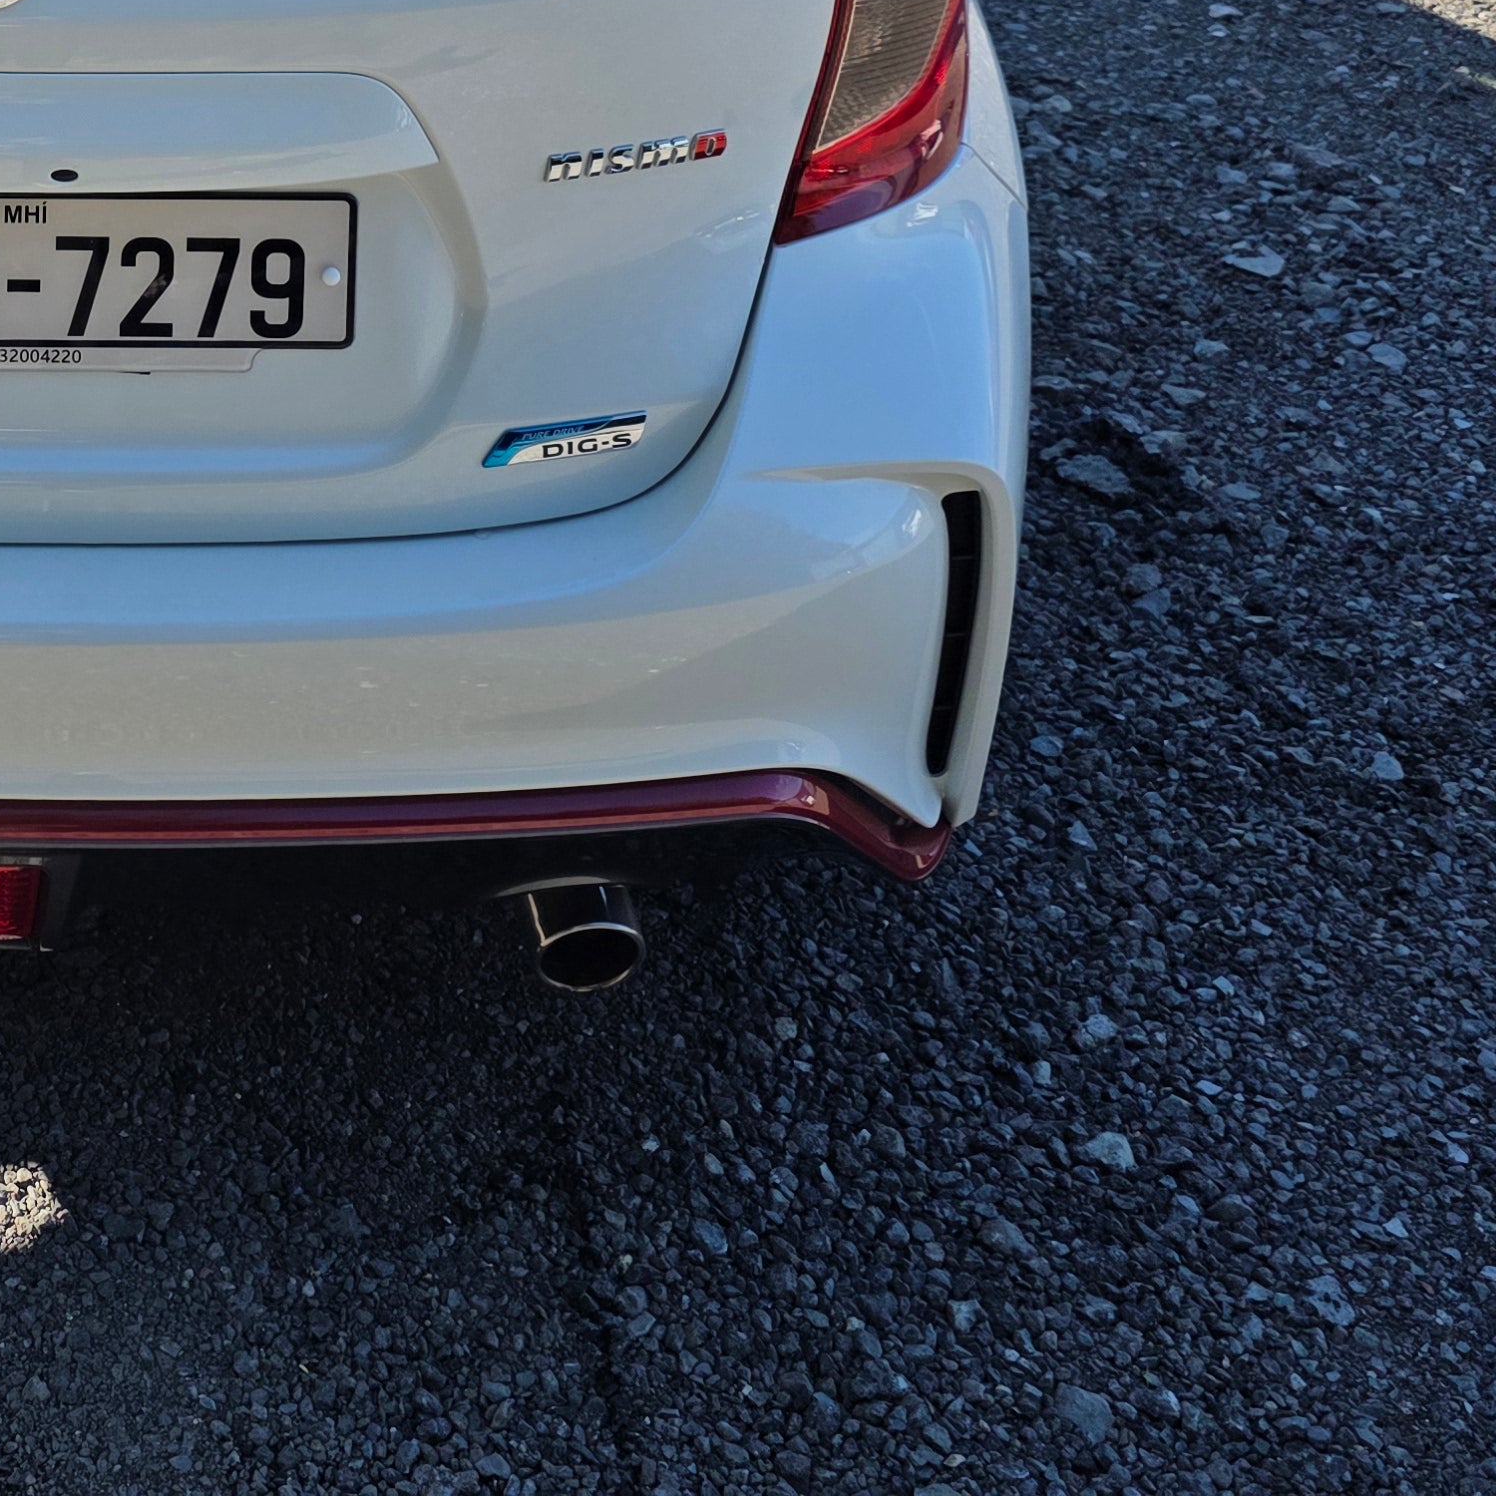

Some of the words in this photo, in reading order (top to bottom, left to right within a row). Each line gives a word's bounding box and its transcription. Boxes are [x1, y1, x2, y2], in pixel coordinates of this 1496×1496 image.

[543, 127, 728, 183] nismo
[4, 200, 48, 225] MHÍ
[521, 430, 551, 441] PURE
[552, 425, 585, 438] DRIVE
[541, 432, 632, 459] DIG-S
